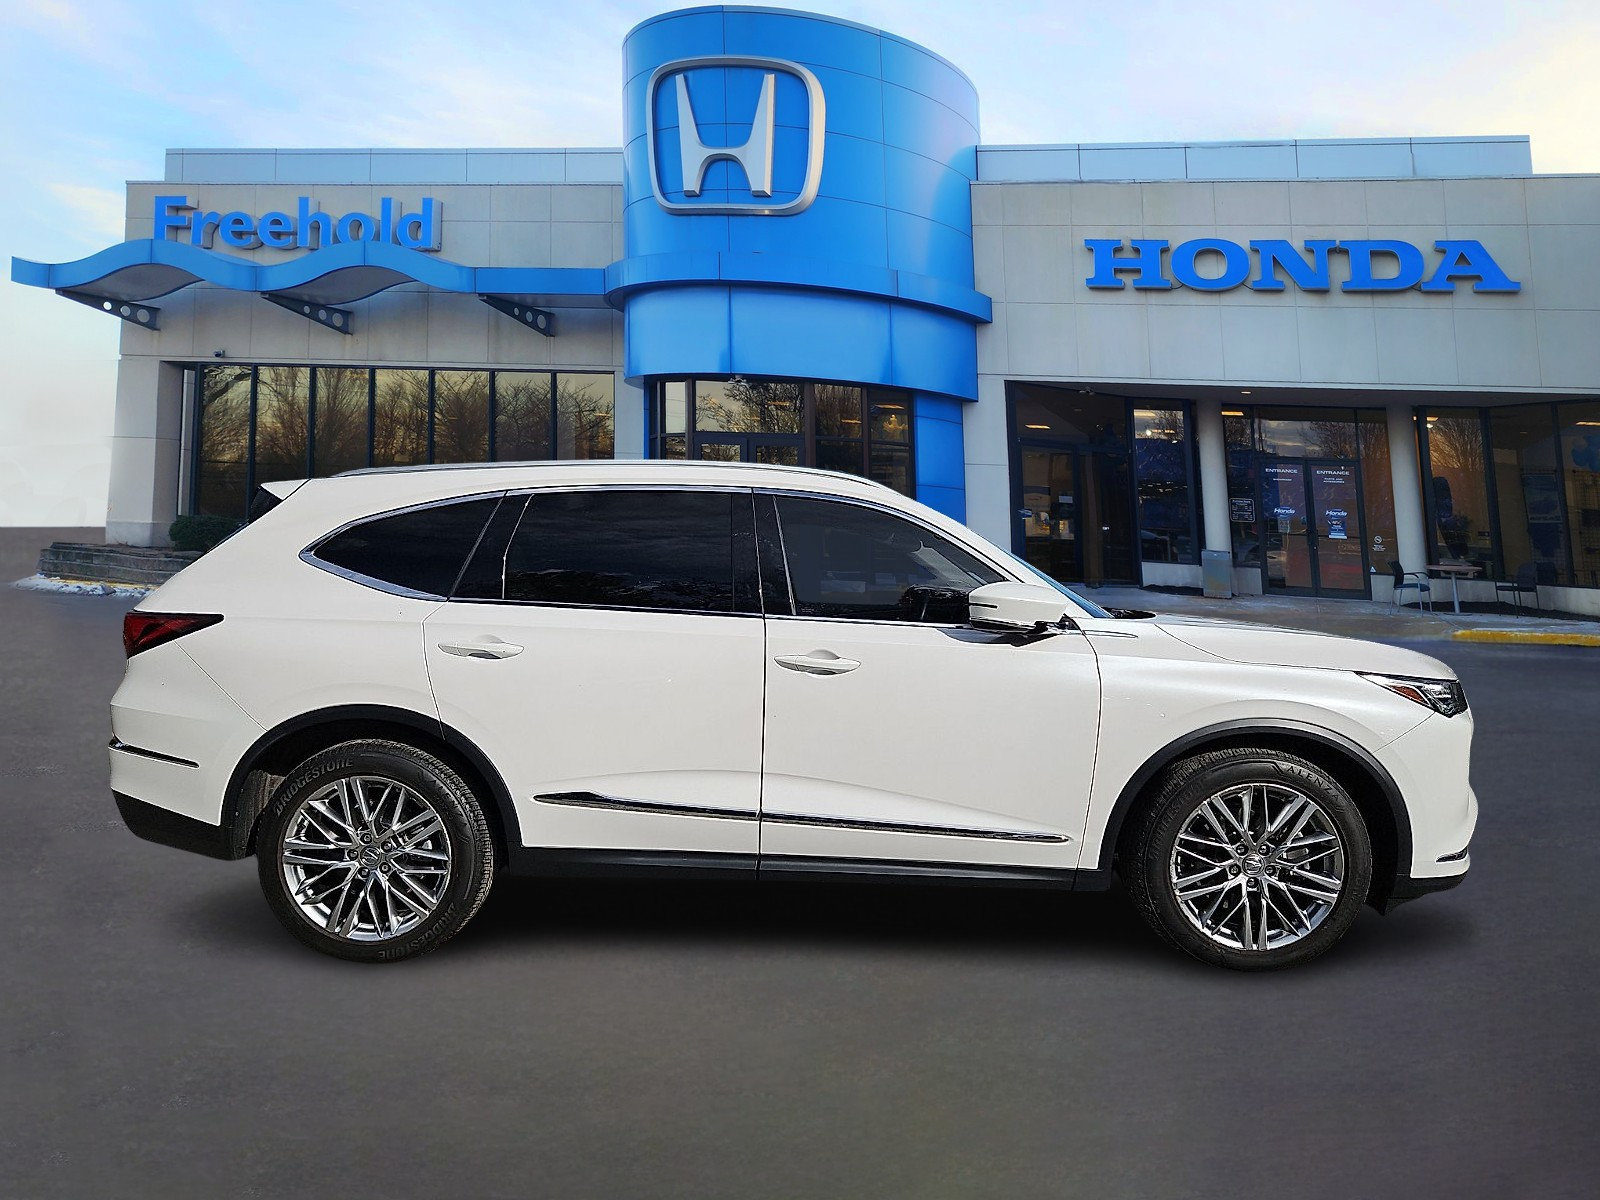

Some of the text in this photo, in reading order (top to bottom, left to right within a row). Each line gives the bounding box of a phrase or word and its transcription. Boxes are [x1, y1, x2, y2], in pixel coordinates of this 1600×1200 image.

[153, 195, 441, 250] Freehold
[1084, 238, 1521, 293] HONDA
[1274, 507, 1295, 515] Honda
[273, 759, 354, 817] BRIDGESTONE
[1286, 765, 1340, 802] ALENZA
